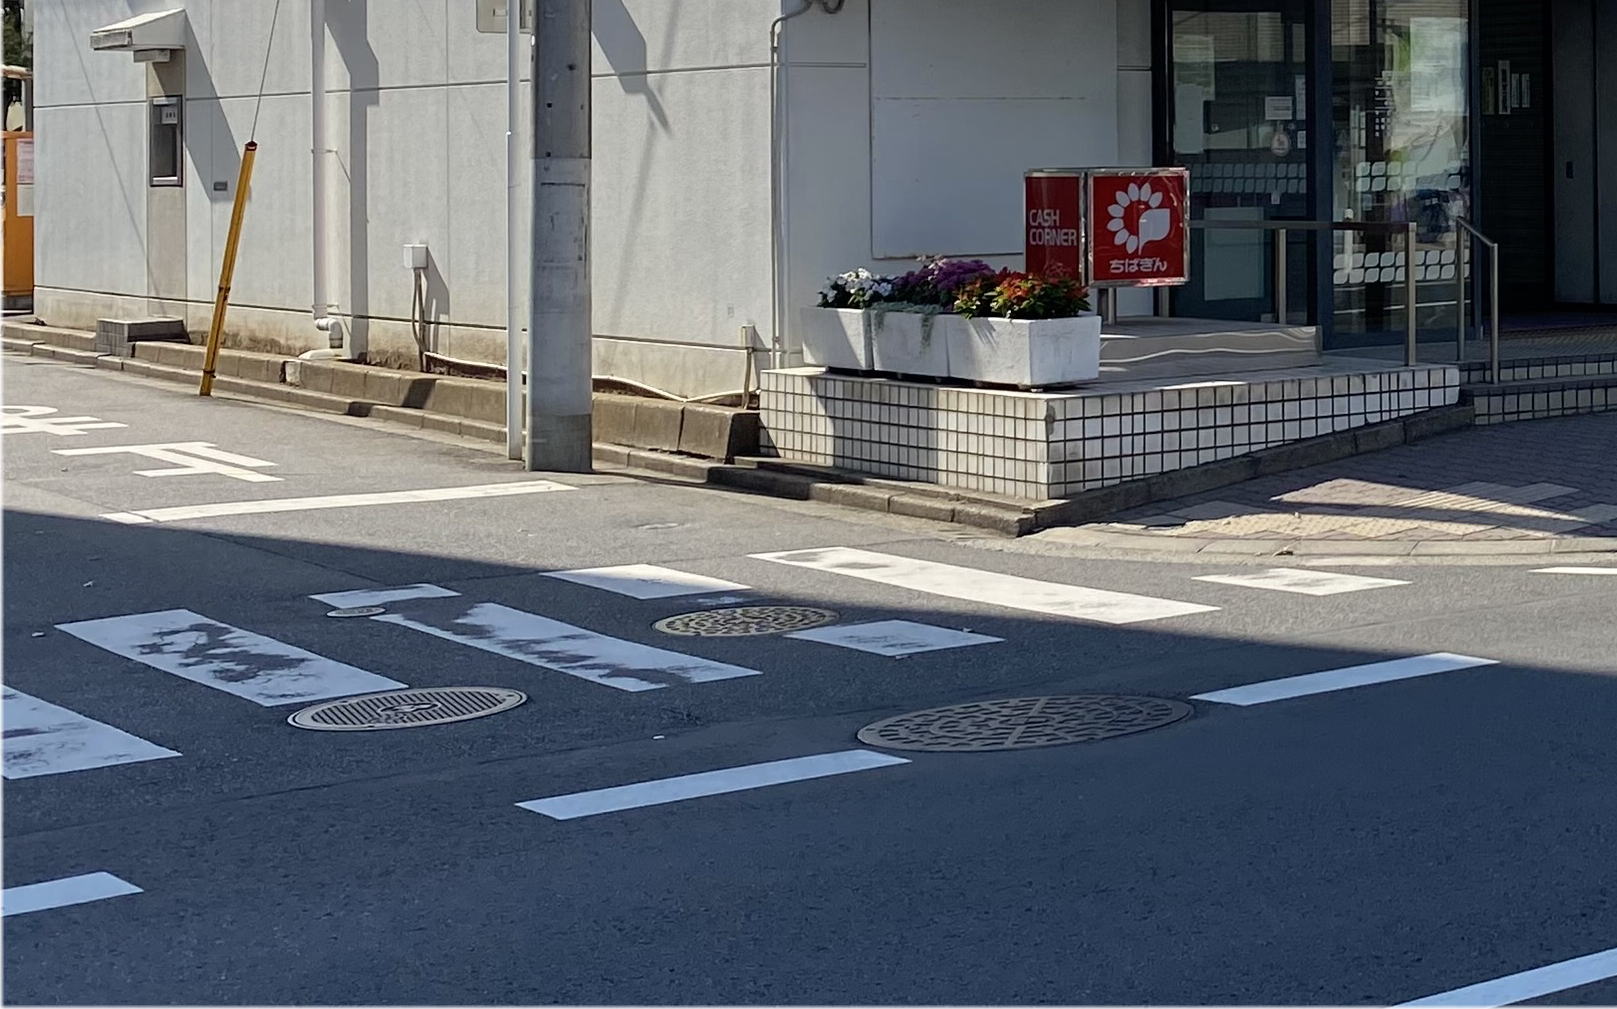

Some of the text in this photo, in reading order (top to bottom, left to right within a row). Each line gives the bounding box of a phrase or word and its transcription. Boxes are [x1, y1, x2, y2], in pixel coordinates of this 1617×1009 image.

[1029, 209, 1060, 226] CASH
[1029, 228, 1078, 246] CORNER
[1109, 257, 1168, 274] ちばぎん
